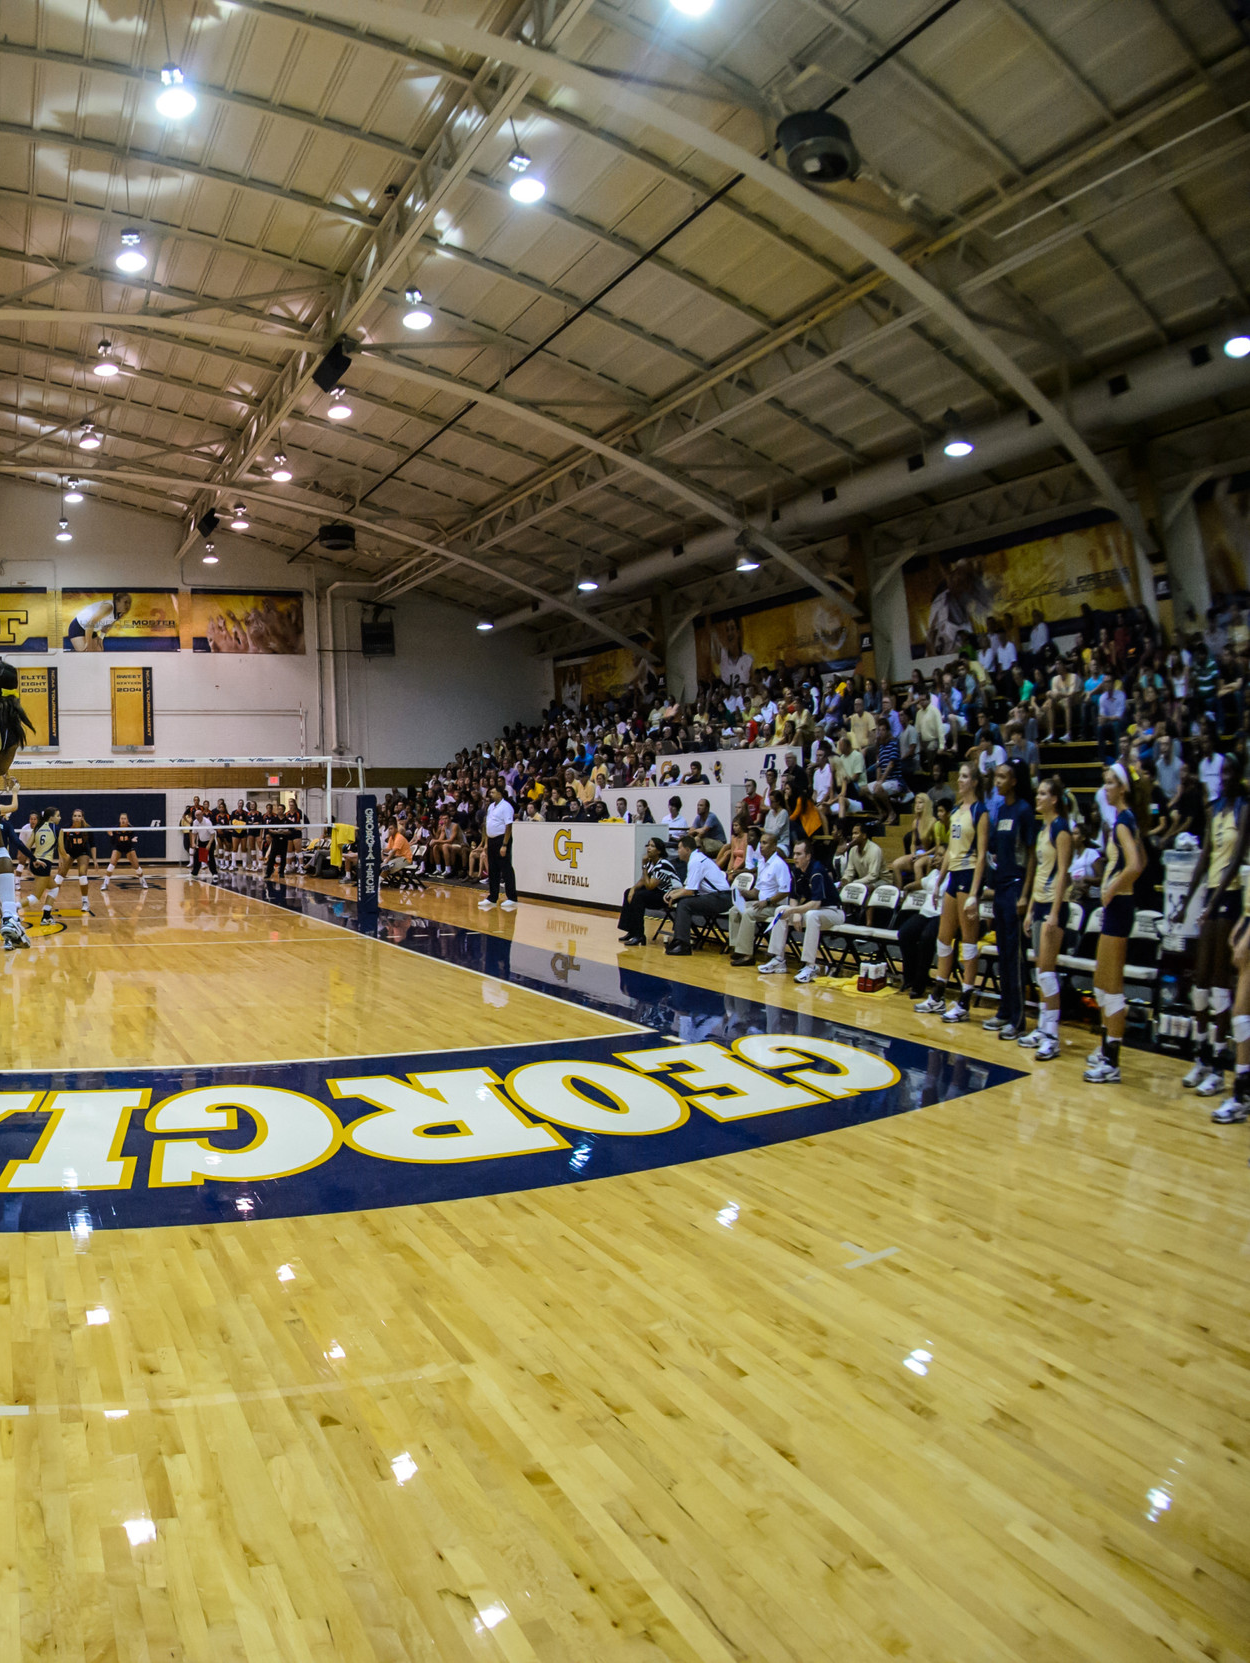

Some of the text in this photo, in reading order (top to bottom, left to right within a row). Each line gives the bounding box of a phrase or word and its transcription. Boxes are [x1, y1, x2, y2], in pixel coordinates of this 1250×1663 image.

[39, 834, 46, 846] 6
[365, 808, 375, 894] GEORGIA TECH
[553, 828, 583, 869] GT
[547, 872, 589, 888] VOLLEYBALL
